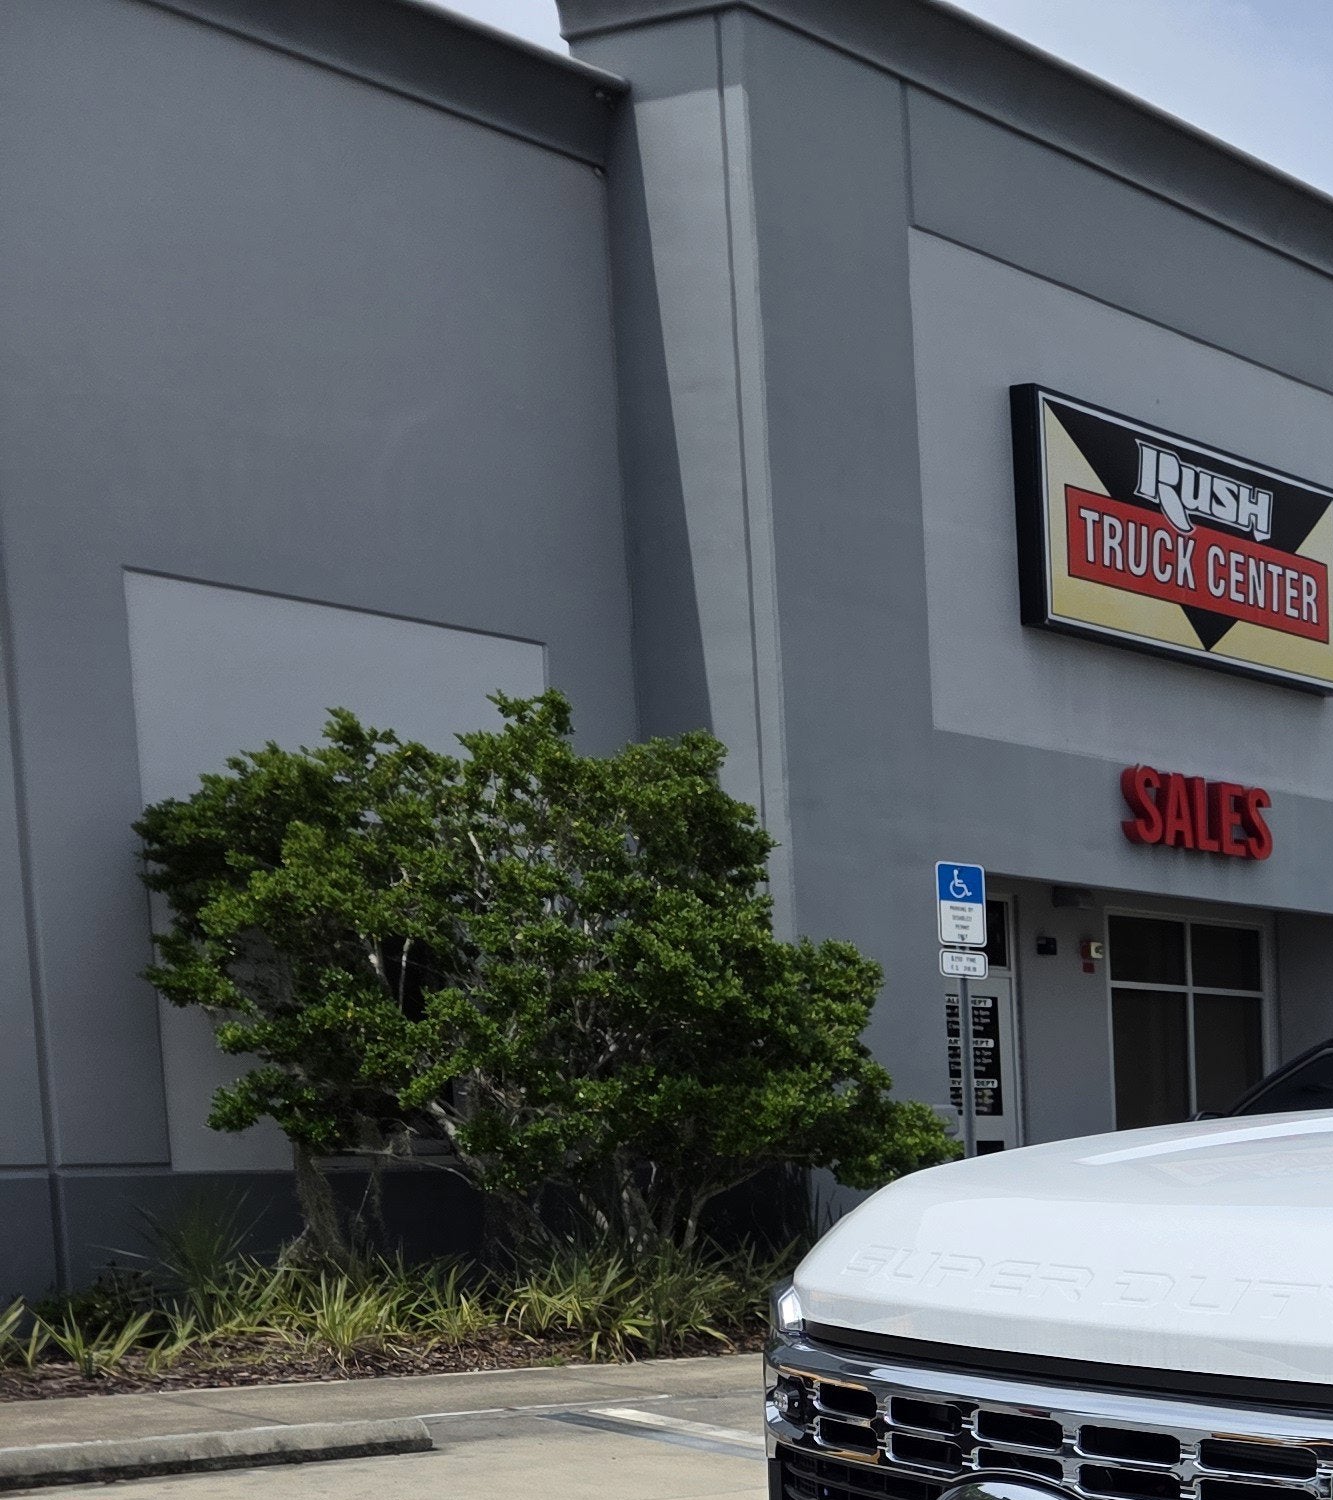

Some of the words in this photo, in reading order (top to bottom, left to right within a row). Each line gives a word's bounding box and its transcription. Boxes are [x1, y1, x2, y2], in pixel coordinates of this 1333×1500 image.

[1078, 506, 1196, 590] TRUCK
[1206, 544, 1319, 625] CENTER
[1120, 764, 1274, 861] SALES
[842, 1243, 1097, 1301] SUPER
